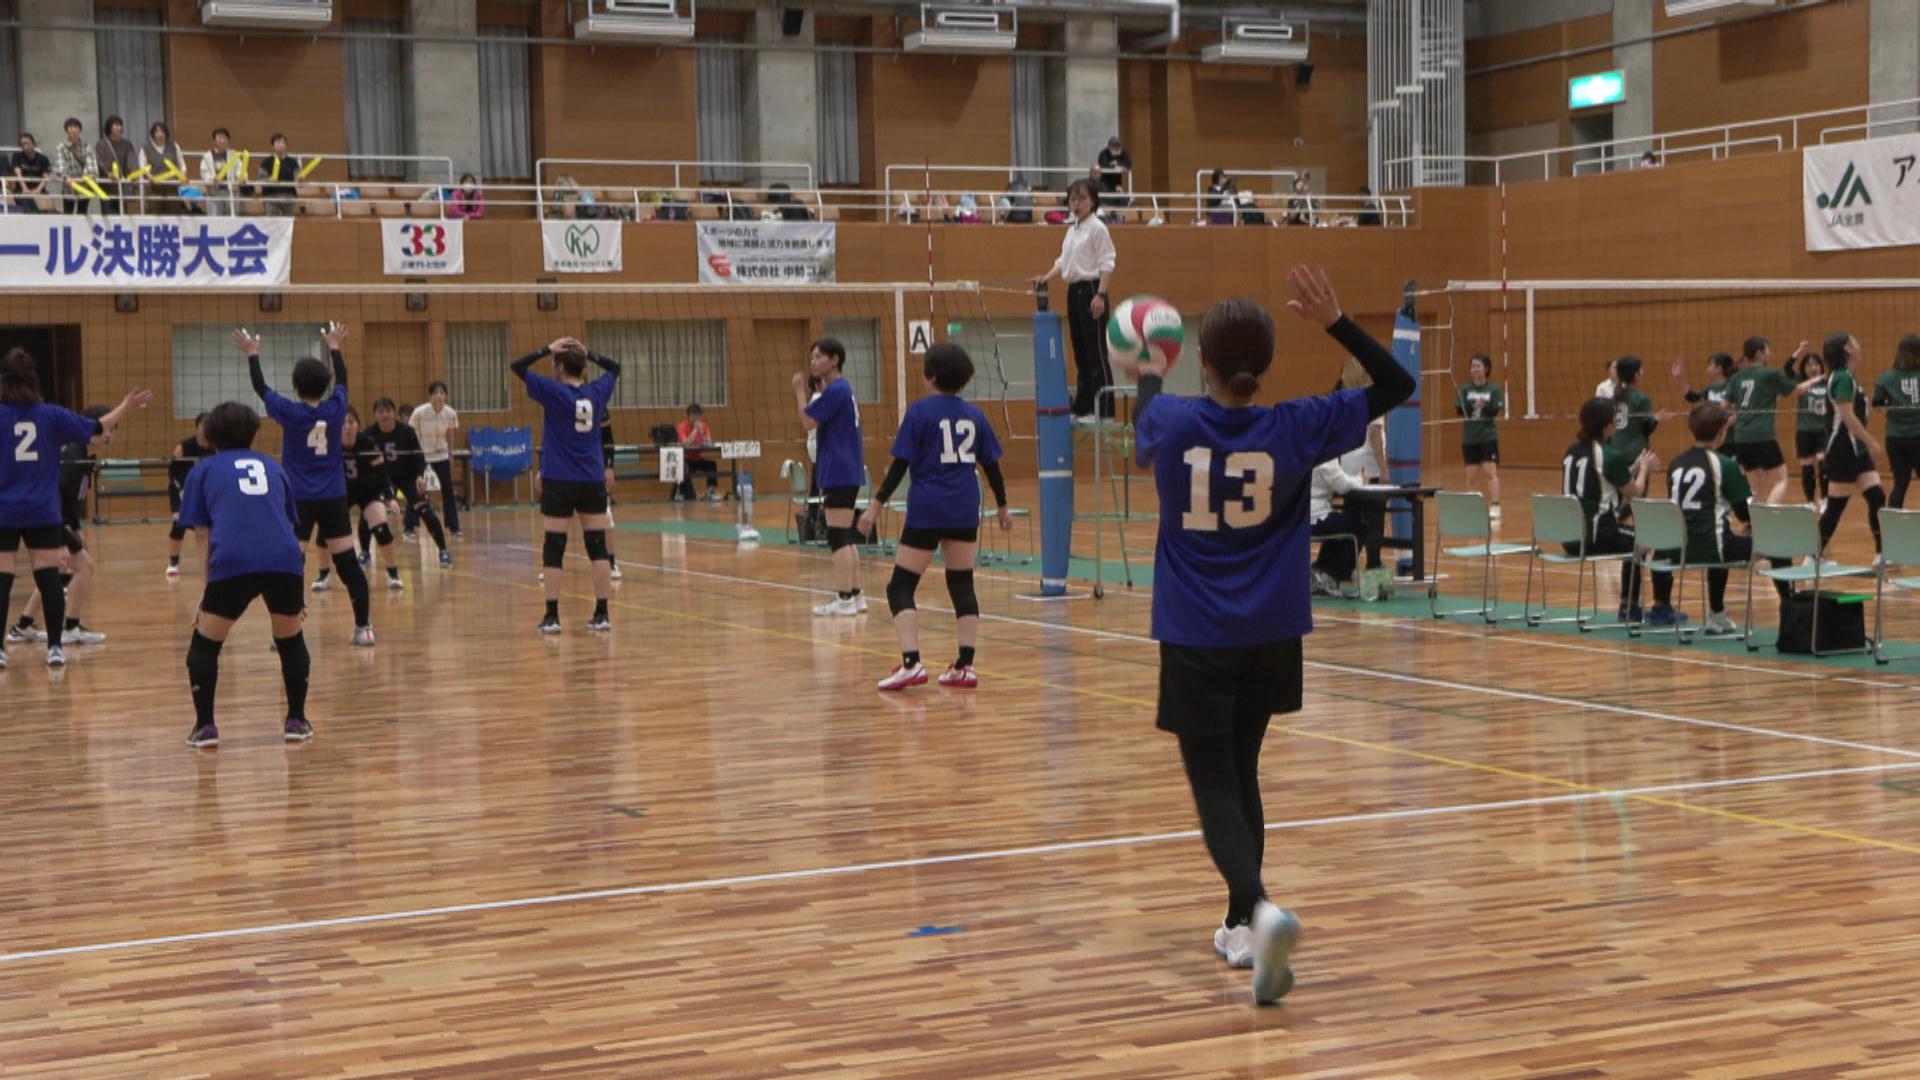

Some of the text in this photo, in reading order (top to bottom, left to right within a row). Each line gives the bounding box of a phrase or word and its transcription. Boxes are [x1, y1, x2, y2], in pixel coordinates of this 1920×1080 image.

[401, 224, 445, 256] 33
[911, 324, 930, 352] A
[1741, 380, 1755, 407] 7
[575, 399, 593, 432] 9
[14, 421, 38, 461] 2
[307, 420, 328, 455] 4
[939, 419, 976, 463] 12
[236, 459, 268, 495] 3
[1182, 446, 1275, 531] 13
[1563, 455, 1588, 499] 11
[1671, 467, 1705, 509] 12
